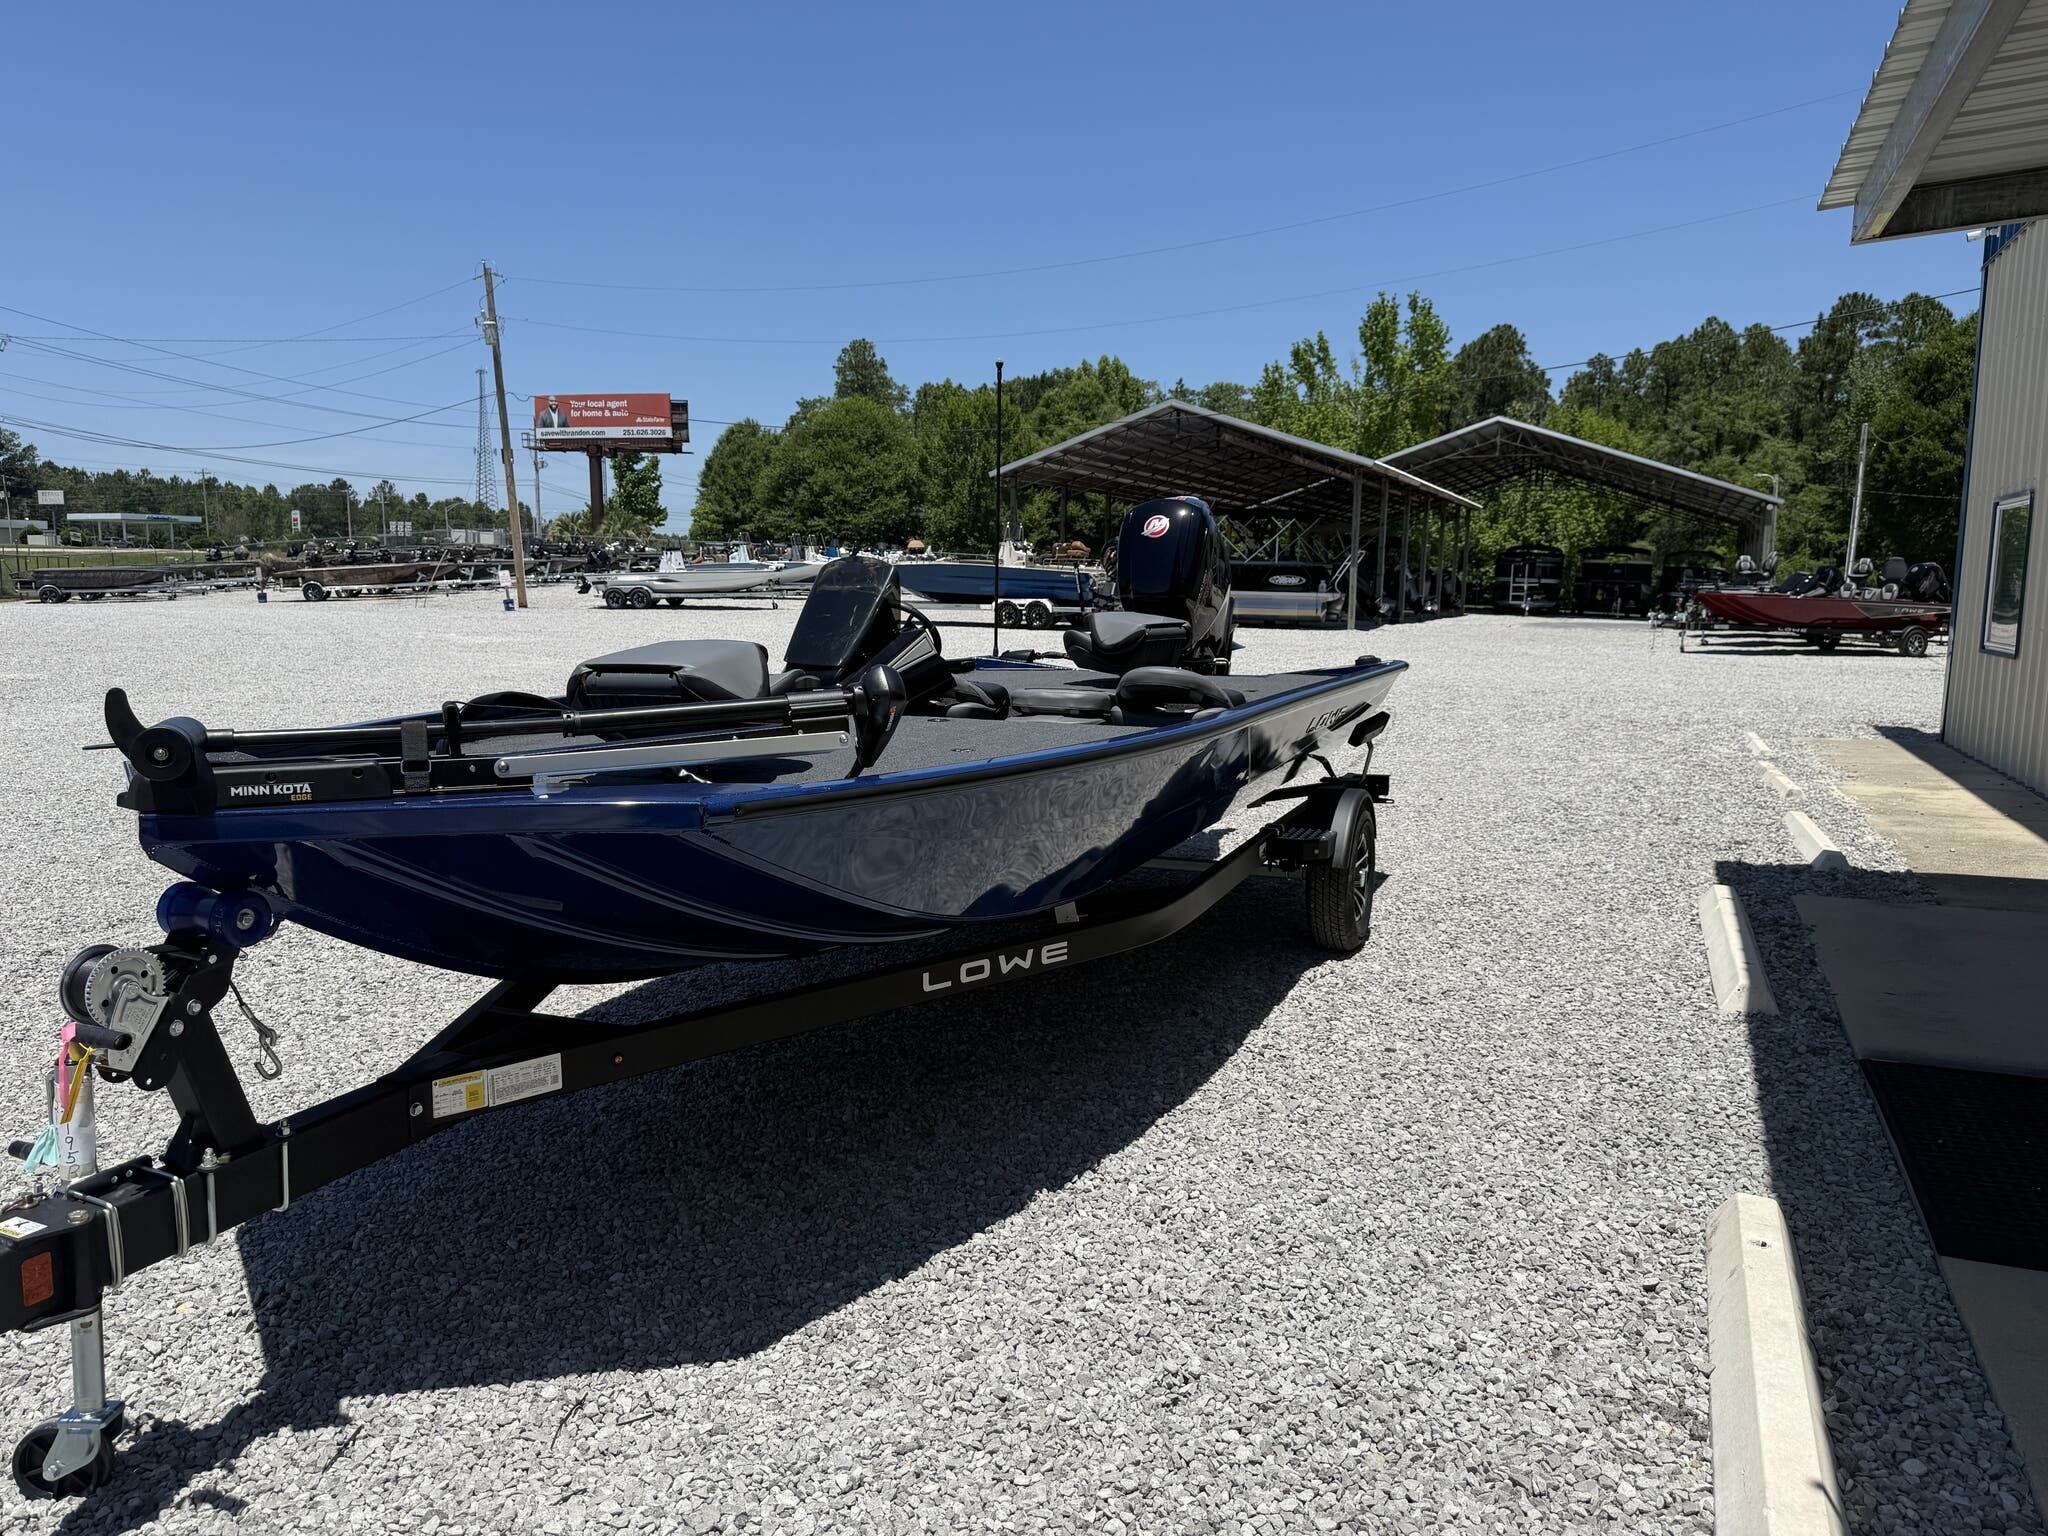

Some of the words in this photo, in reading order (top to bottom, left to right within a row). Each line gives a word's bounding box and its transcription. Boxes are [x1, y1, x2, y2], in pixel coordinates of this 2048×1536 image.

[570, 400, 586, 408] Your
[587, 399, 605, 407] local
[606, 400, 628, 409] agent
[570, 409, 581, 417] for
[582, 409, 603, 417] home
[612, 409, 629, 417] auto
[230, 785, 270, 797] MINN
[273, 783, 312, 795] KOTA
[922, 941, 1068, 992] LOWE
